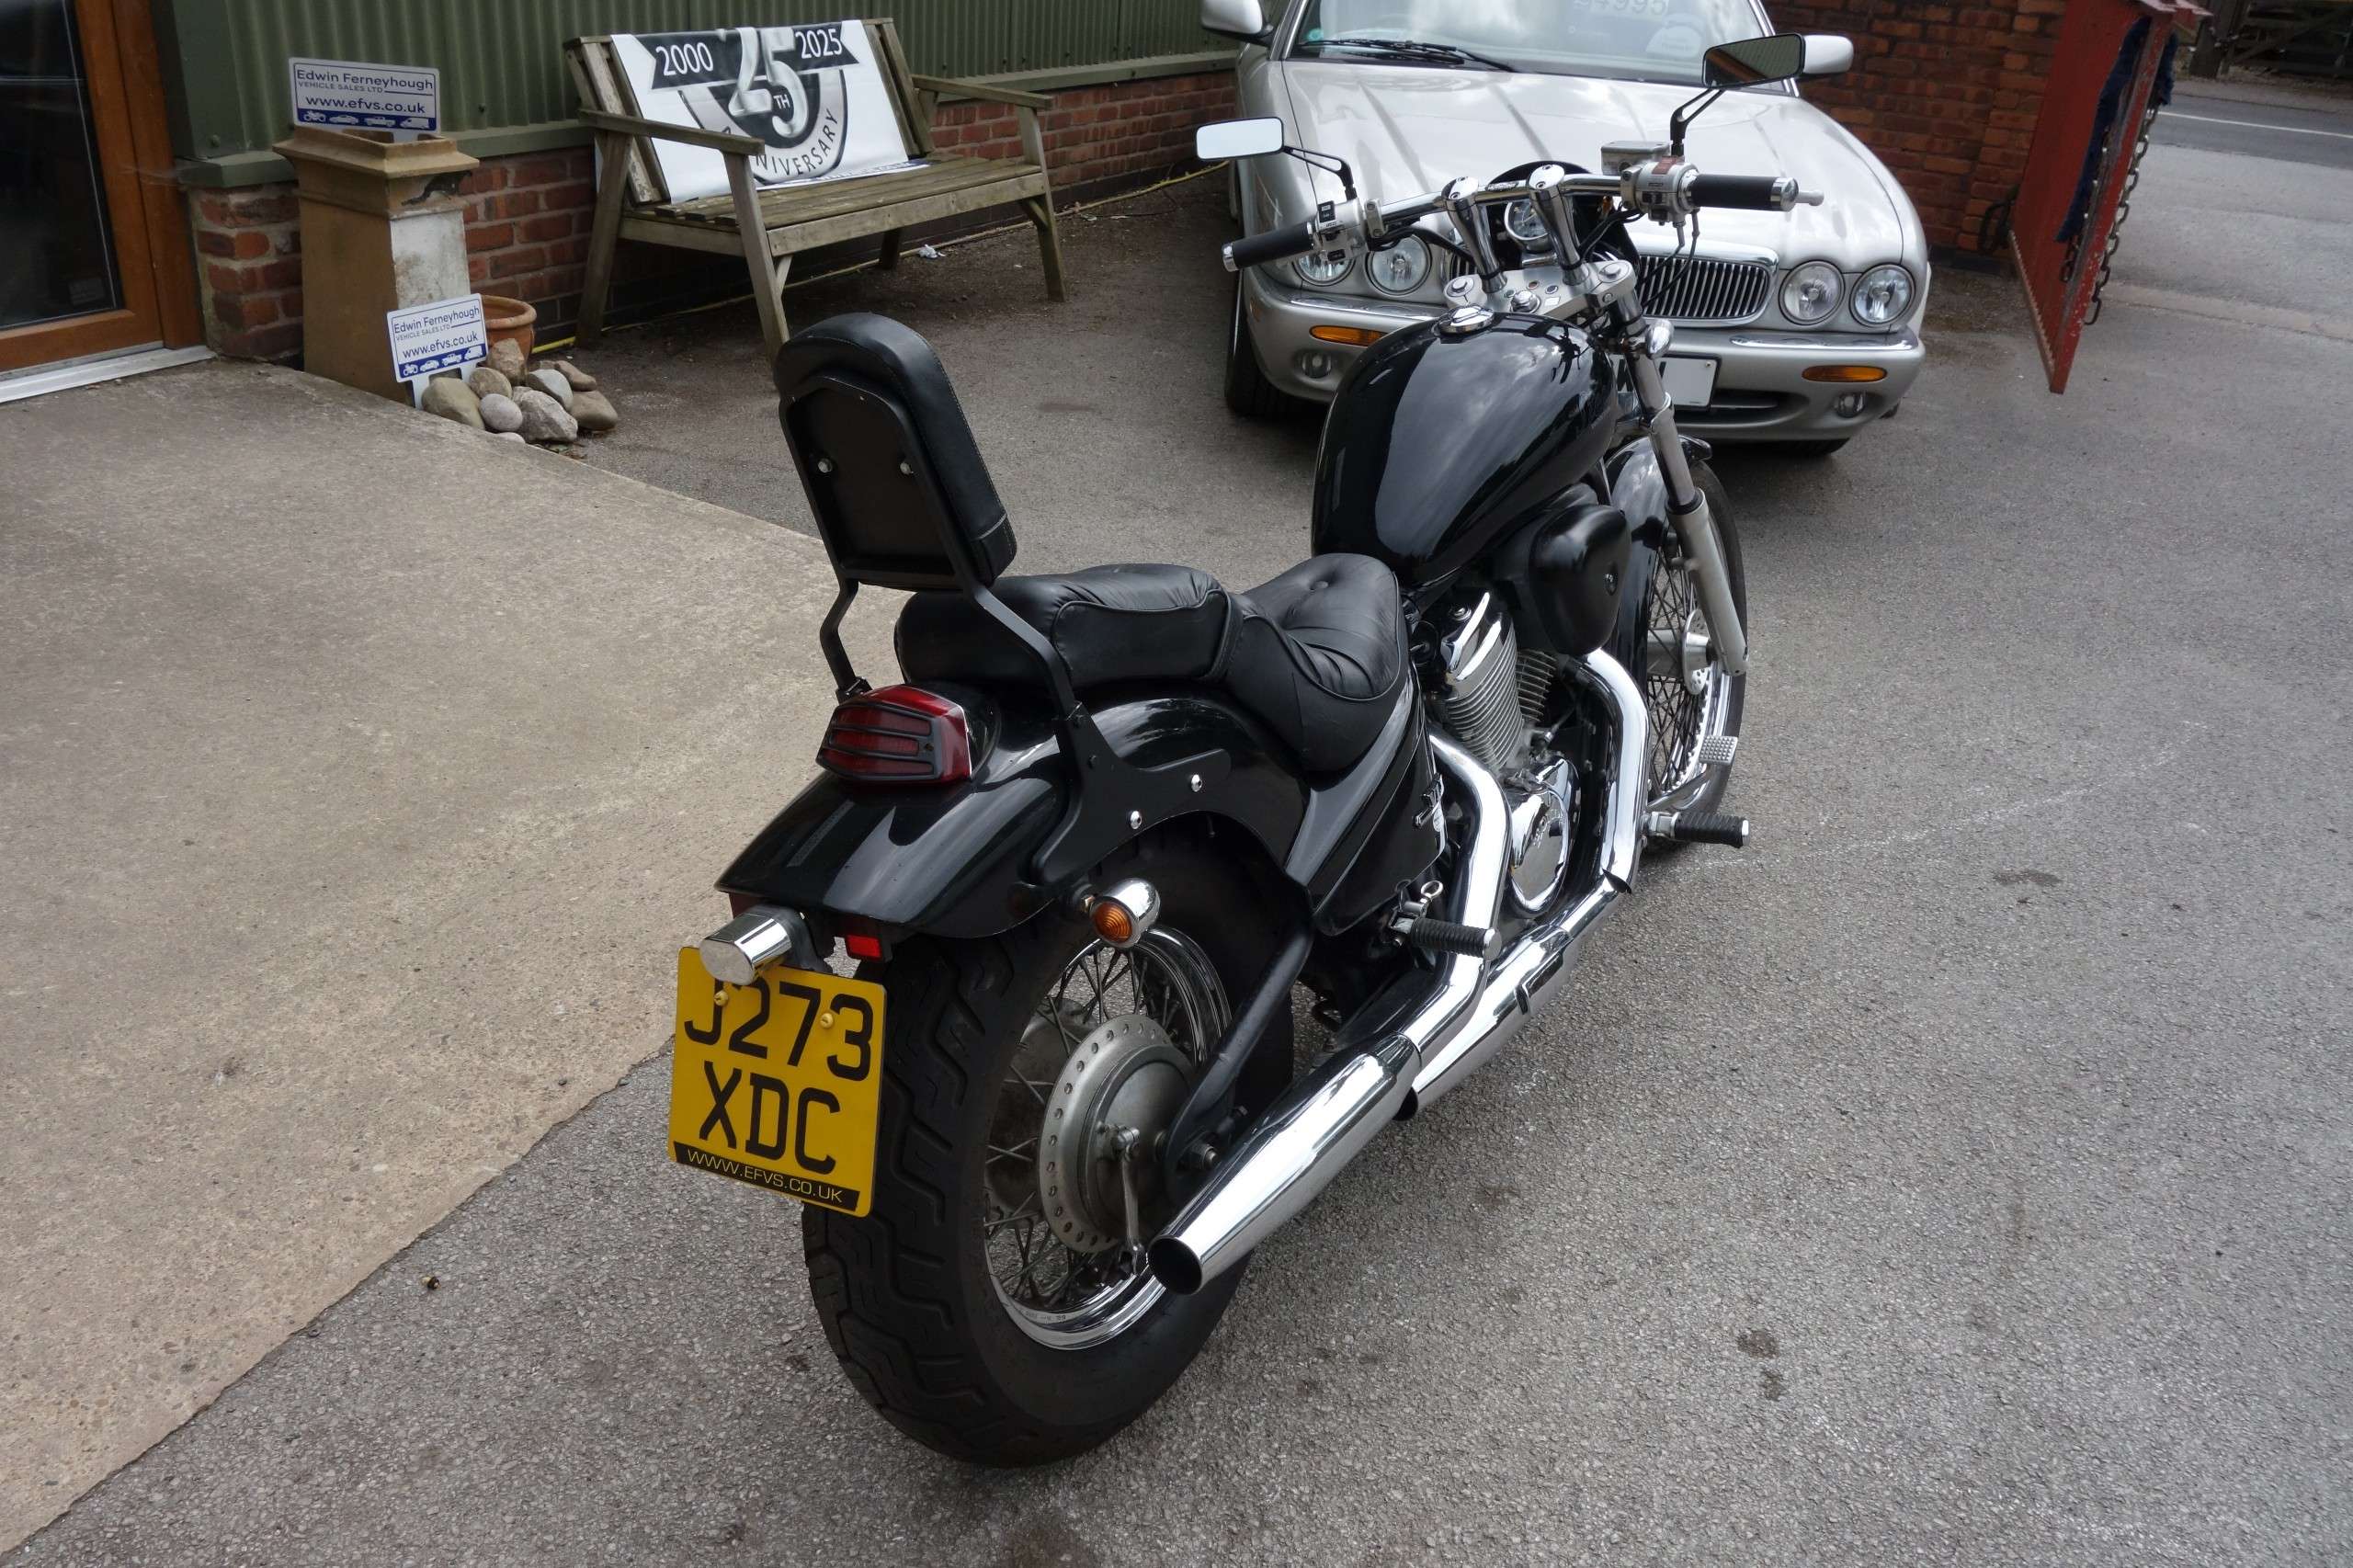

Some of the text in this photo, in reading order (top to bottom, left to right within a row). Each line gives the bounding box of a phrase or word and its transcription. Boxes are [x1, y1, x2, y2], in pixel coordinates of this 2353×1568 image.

[795, 28, 843, 60] 2025
[655, 42, 714, 76] 2000
[297, 69, 433, 90] Edwin Ferneyhough
[298, 81, 335, 90] VEHICLE
[306, 96, 426, 113] www.efvs.co.uk
[774, 94, 790, 110] TH
[722, 108, 838, 176] NIVERSARY
[394, 306, 480, 334] Edwin Ferneyhough
[396, 333, 420, 341] VEHICLE
[422, 327, 439, 335] SALES
[403, 331, 478, 358] www.efvs.co.uk
[684, 977, 874, 1082] J273
[699, 1061, 841, 1176] XDC
[687, 1150, 844, 1203] WWW.EFVS.CO.UK
